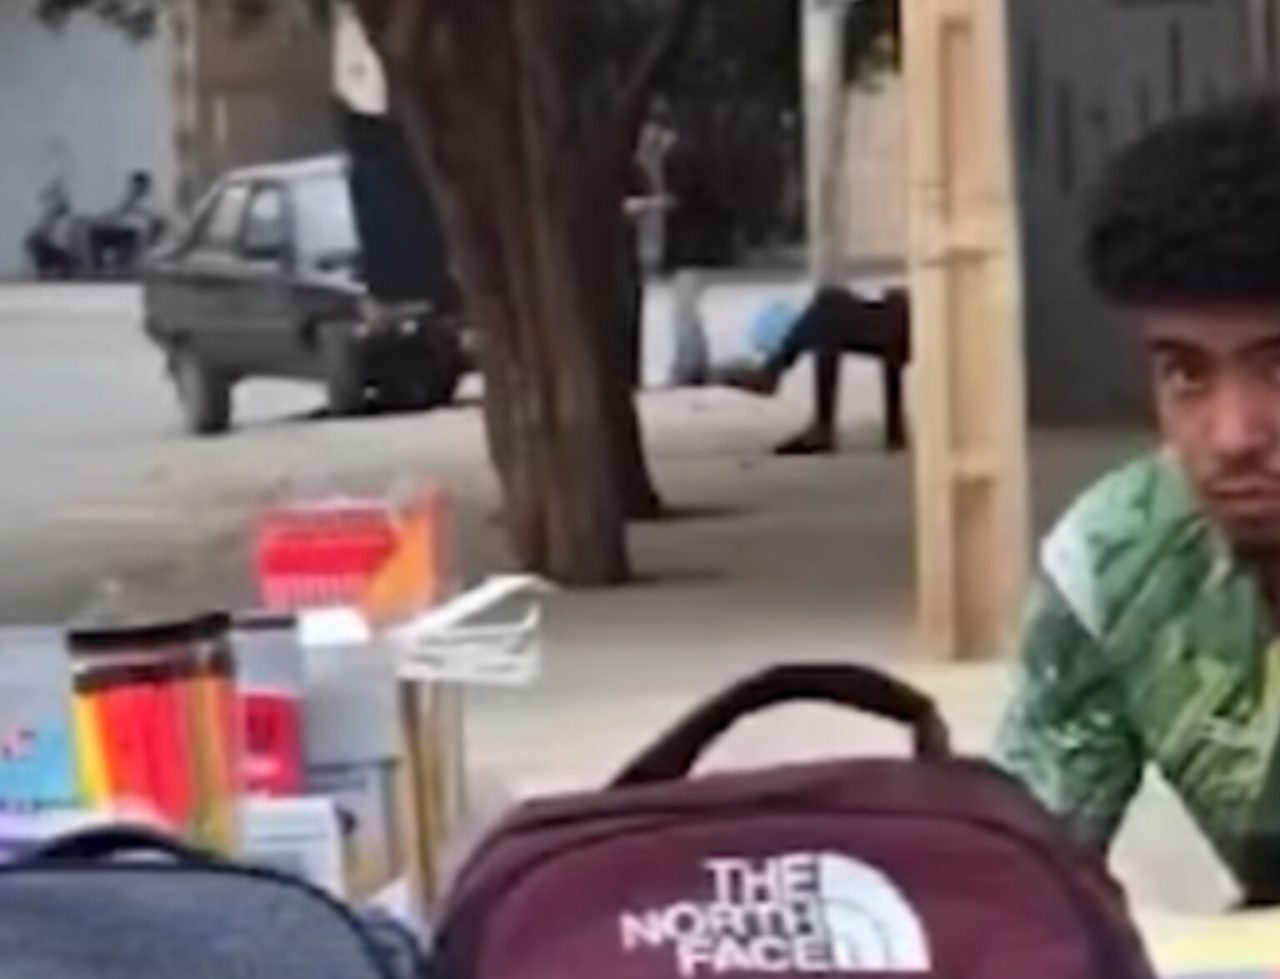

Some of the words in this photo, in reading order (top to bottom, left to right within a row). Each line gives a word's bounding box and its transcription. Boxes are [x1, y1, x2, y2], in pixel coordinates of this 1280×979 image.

[703, 854, 819, 904] THE
[619, 900, 824, 951] NORTH
[676, 936, 834, 977] FACE
